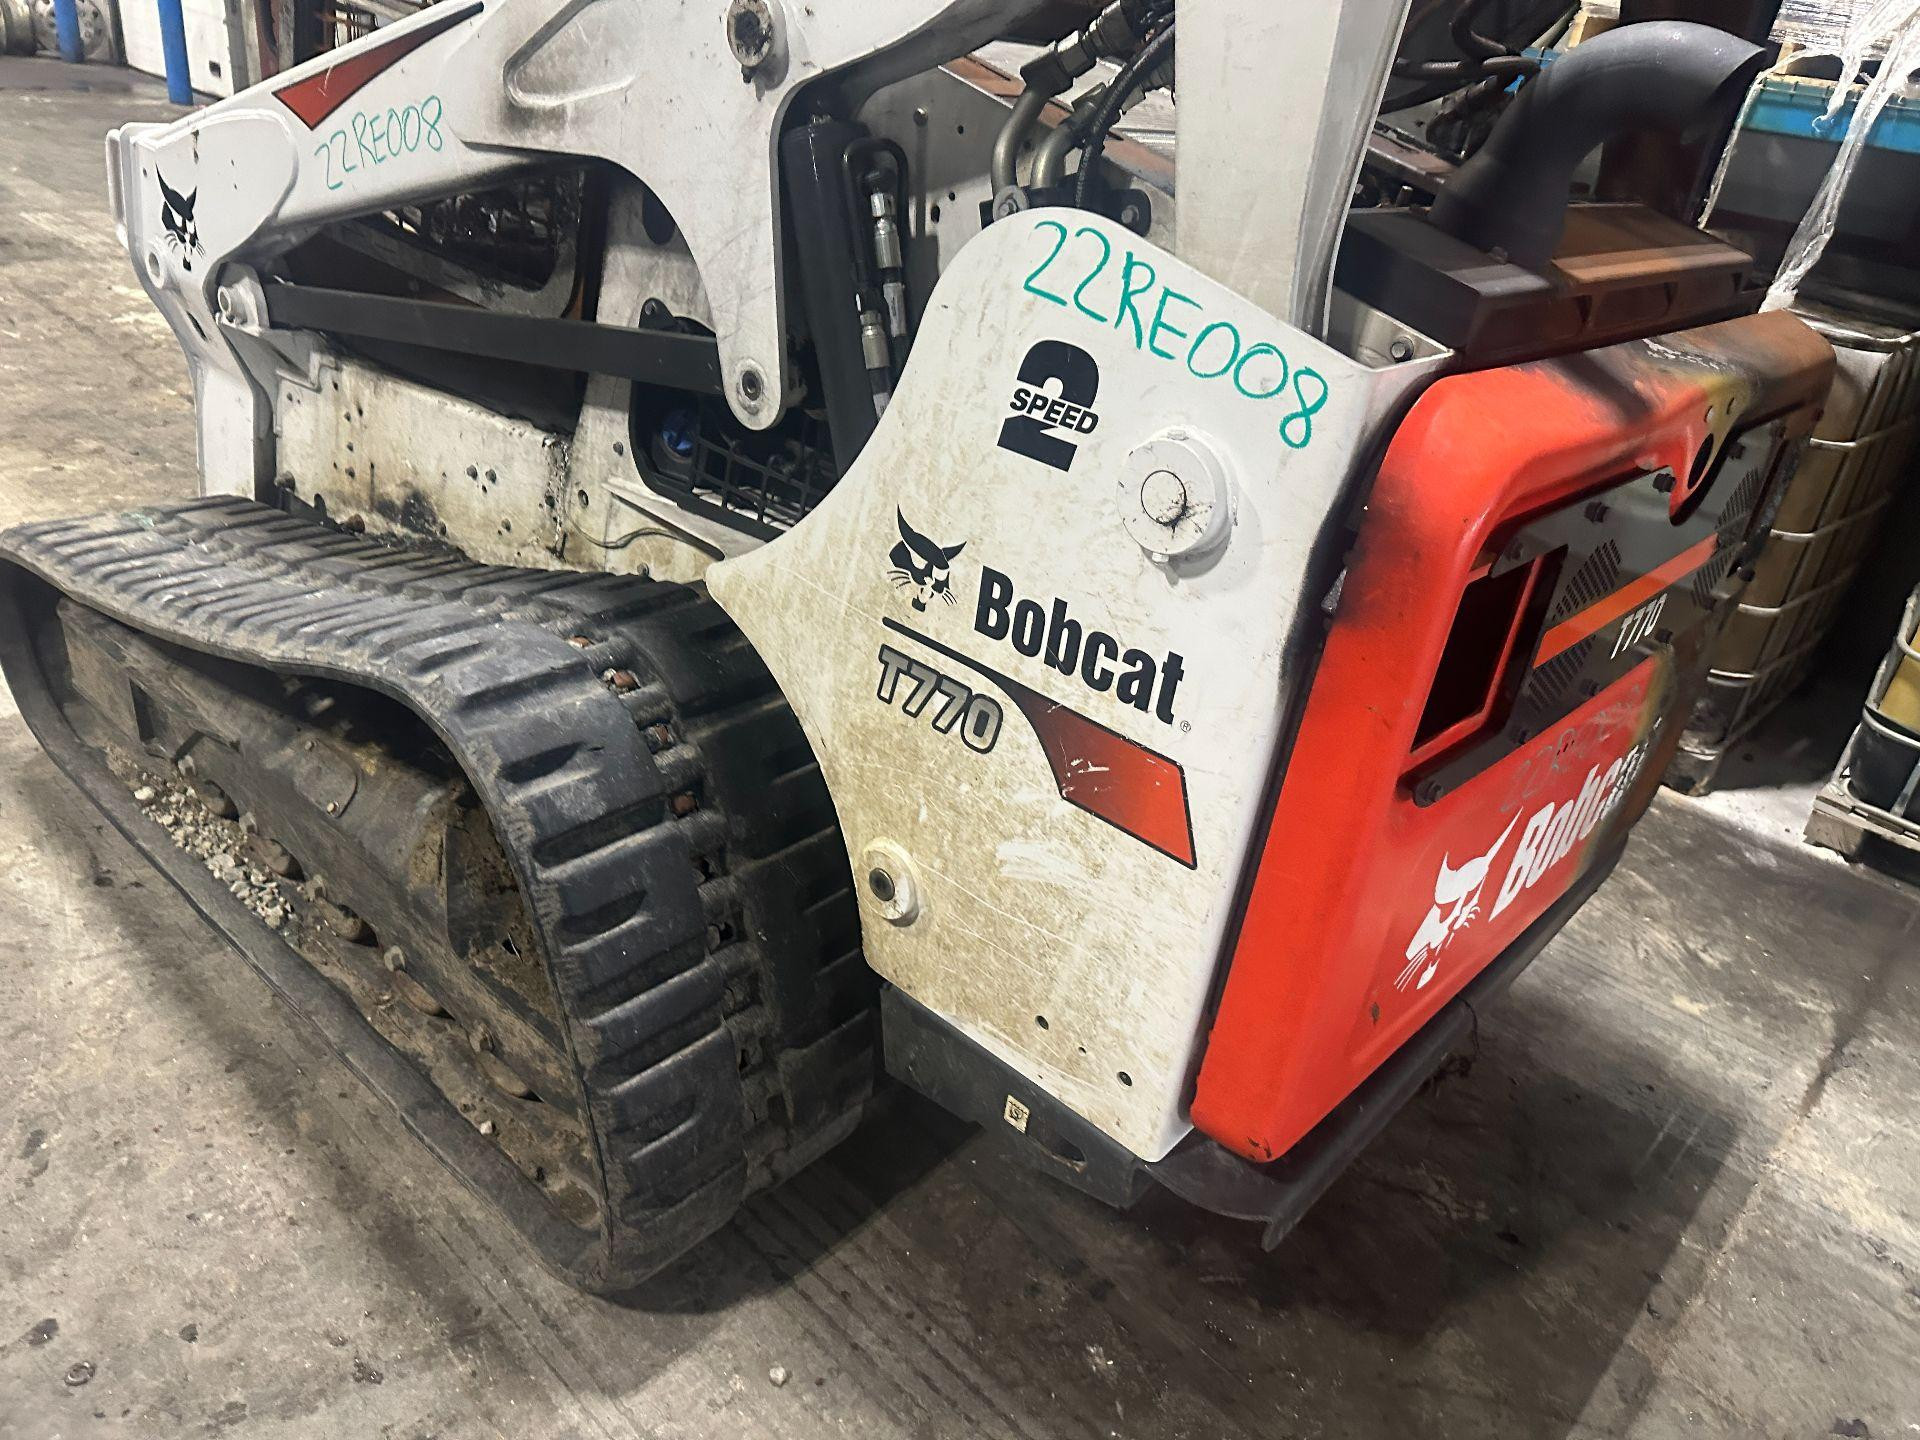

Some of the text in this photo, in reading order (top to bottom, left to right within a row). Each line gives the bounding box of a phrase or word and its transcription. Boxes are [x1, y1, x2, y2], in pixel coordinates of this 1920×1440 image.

[314, 95, 443, 190] 22RE008
[1023, 221, 1328, 449] 22RE008
[997, 340, 1099, 472] 2 SPEED
[974, 565, 1184, 725] Bobcat
[1610, 593, 1668, 659] T770
[877, 644, 1003, 755] T770
